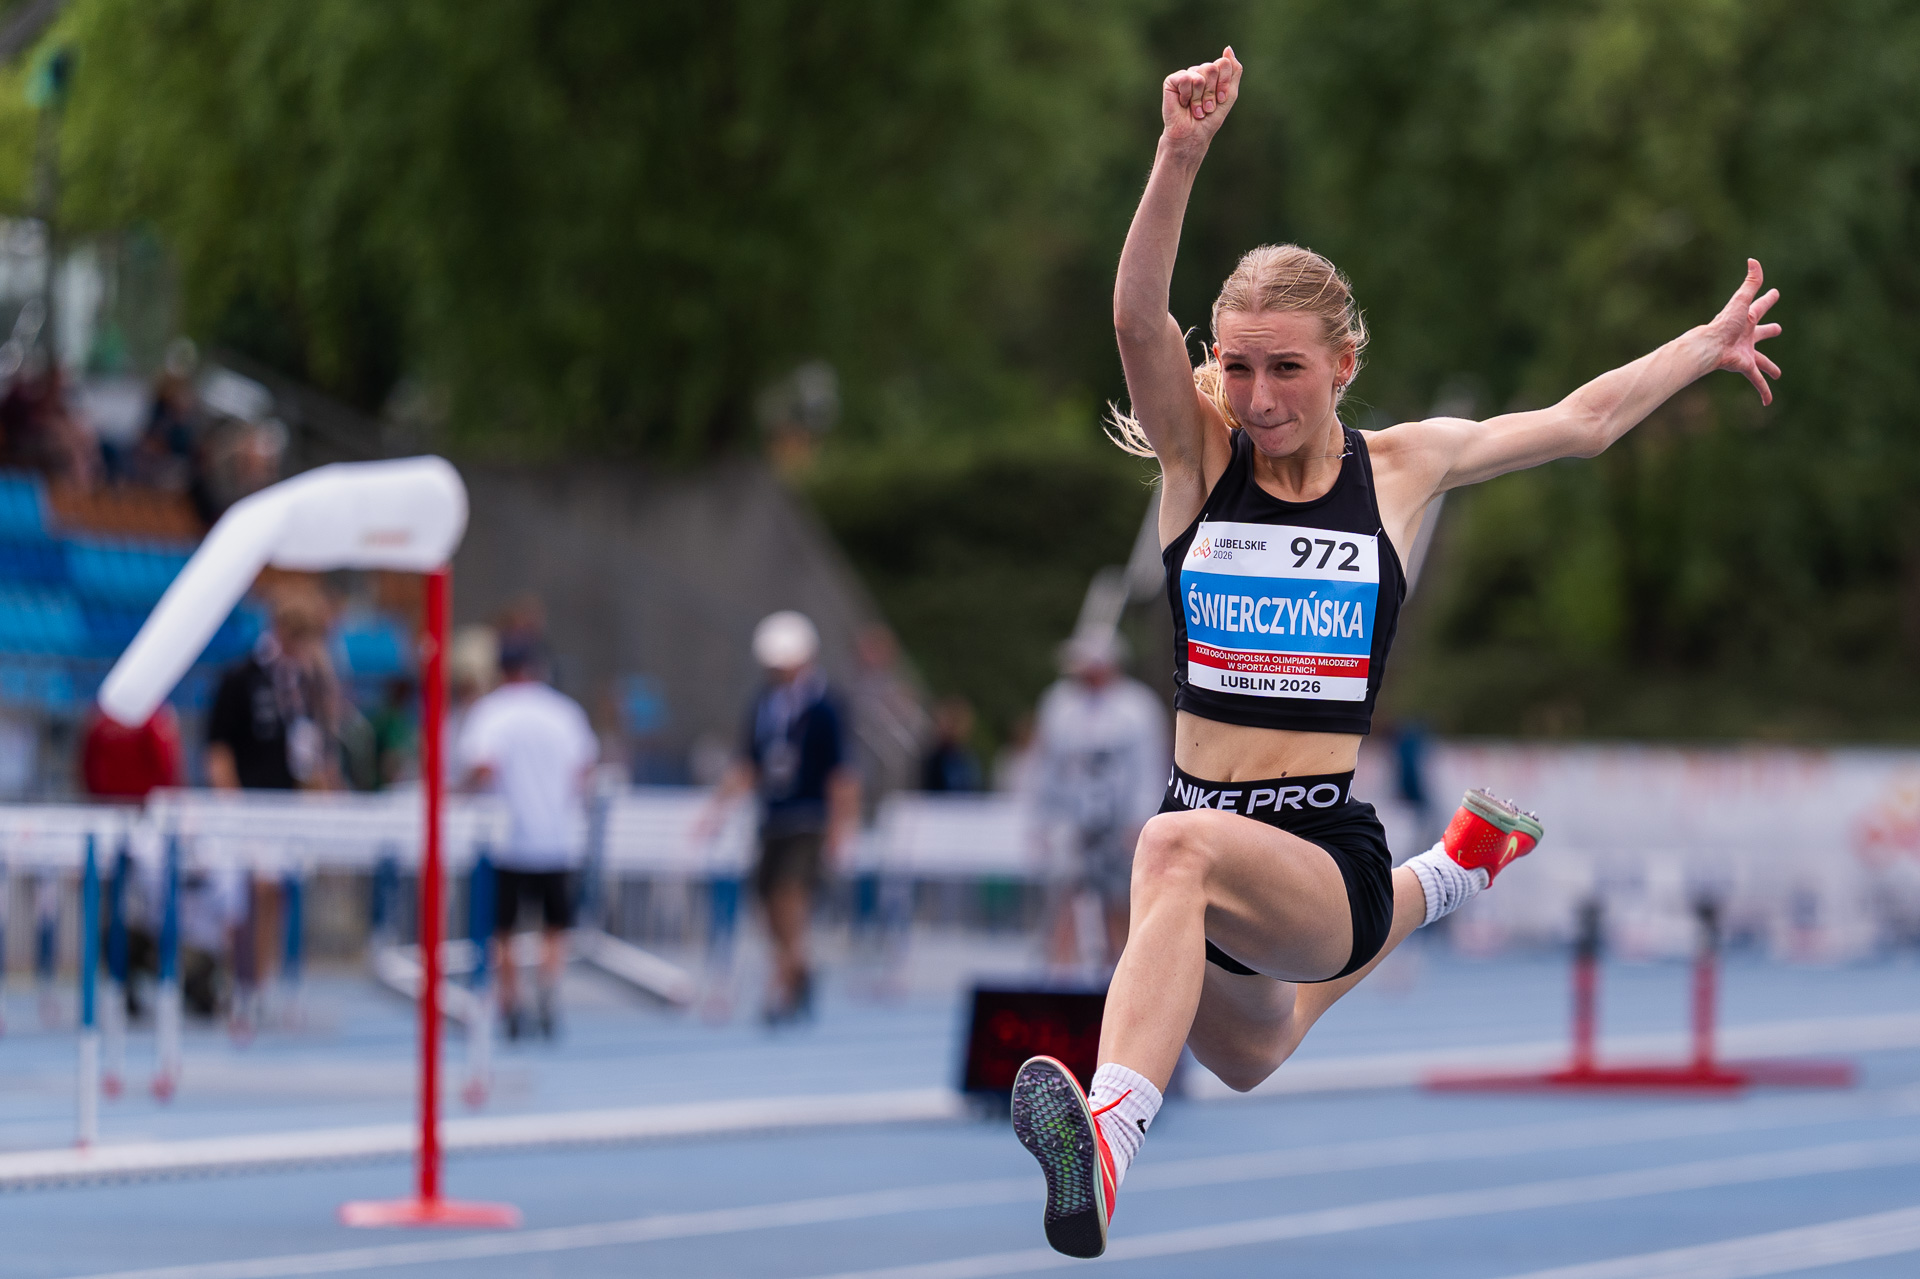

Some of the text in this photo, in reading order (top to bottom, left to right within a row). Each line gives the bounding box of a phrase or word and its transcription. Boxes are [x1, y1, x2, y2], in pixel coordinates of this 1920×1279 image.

[1214, 538, 1267, 551] LUBELSKIE
[1213, 550, 1233, 560] 2026
[1290, 536, 1360, 572] 972
[1188, 583, 1363, 638] ŚWIERCZYŃSKA
[1210, 650, 1270, 663] OGÓLNOPOLSKA
[1272, 656, 1316, 665] OLIMPIADA
[1318, 658, 1359, 668] MŁODZIEŻY
[1227, 662, 1316, 675] W SPORTACH LETNICH
[1221, 675, 1321, 693] LUBLIN 2026
[1174, 777, 1243, 814] NIKE
[1246, 783, 1340, 815] PRO
